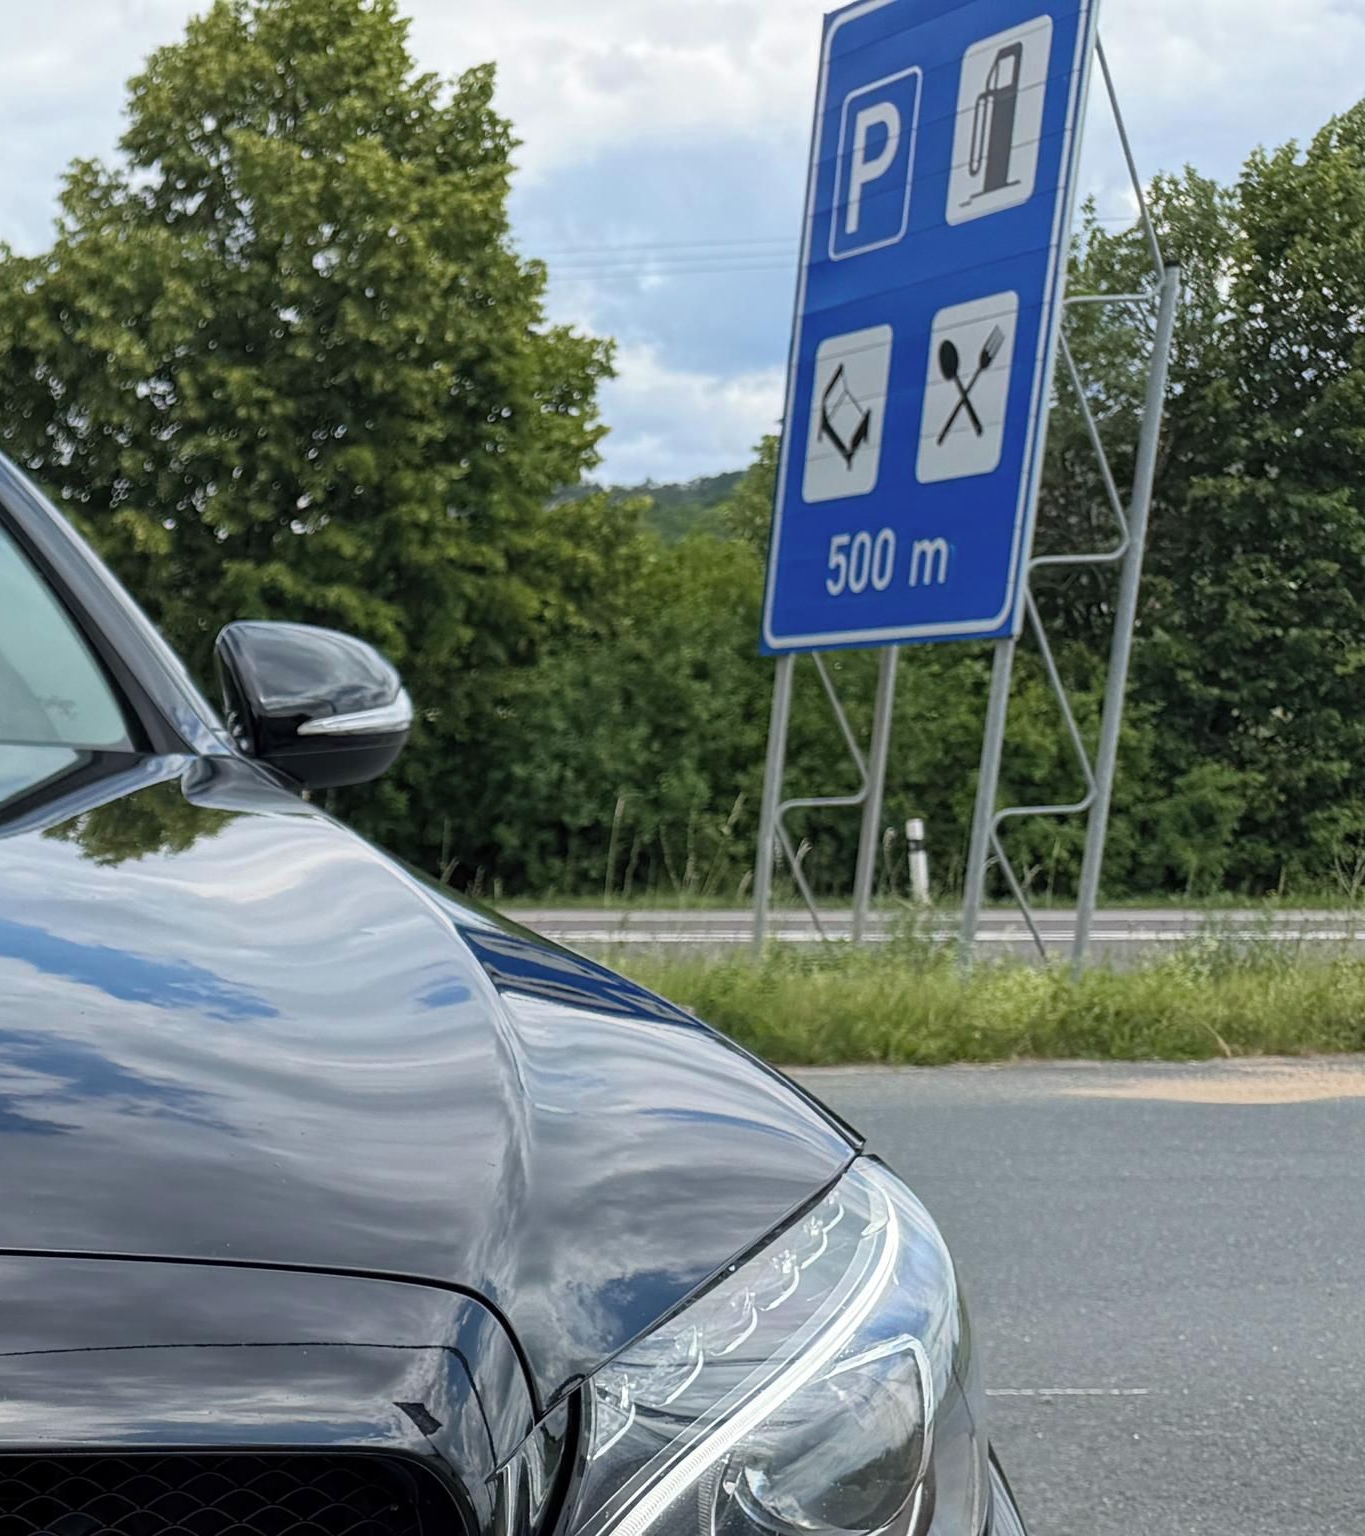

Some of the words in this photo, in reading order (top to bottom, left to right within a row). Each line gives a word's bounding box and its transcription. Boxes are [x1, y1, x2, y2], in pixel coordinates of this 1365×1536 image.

[845, 101, 901, 234] P
[826, 527, 896, 596] 500
[909, 537, 948, 587] m
